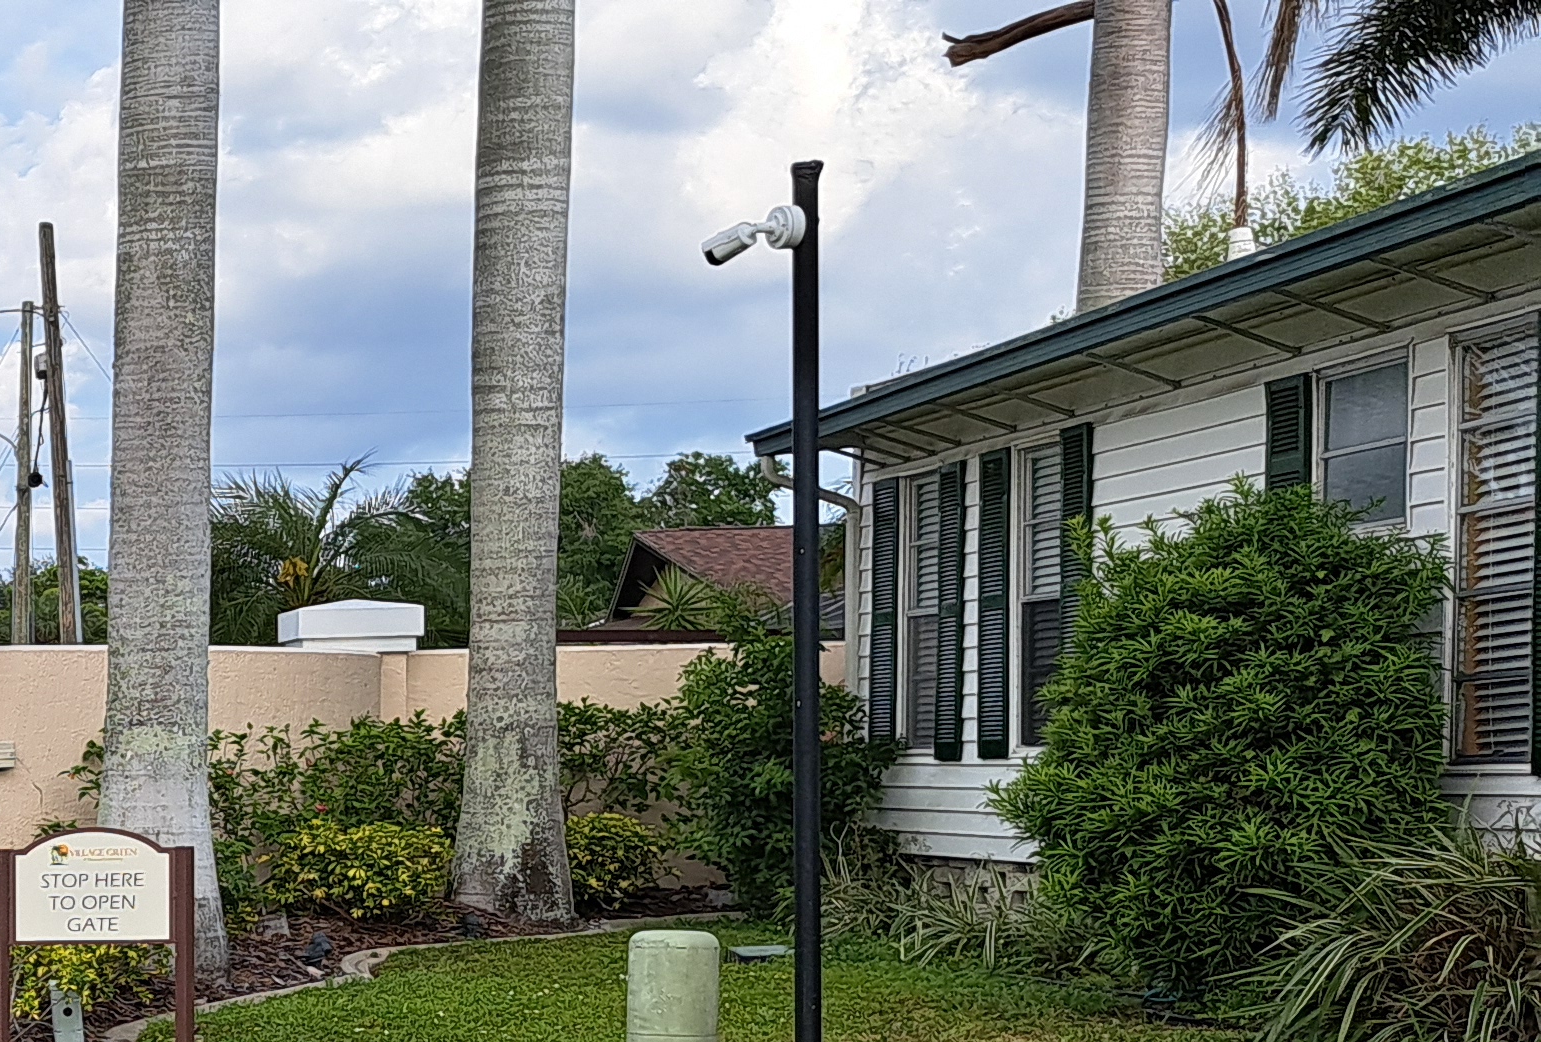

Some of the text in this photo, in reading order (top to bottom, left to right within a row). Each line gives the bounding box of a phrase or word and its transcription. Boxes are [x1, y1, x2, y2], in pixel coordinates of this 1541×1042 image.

[40, 872, 145, 889] STOP HERE
[48, 895, 136, 911] TO OPEN
[67, 917, 119, 932] GATE
